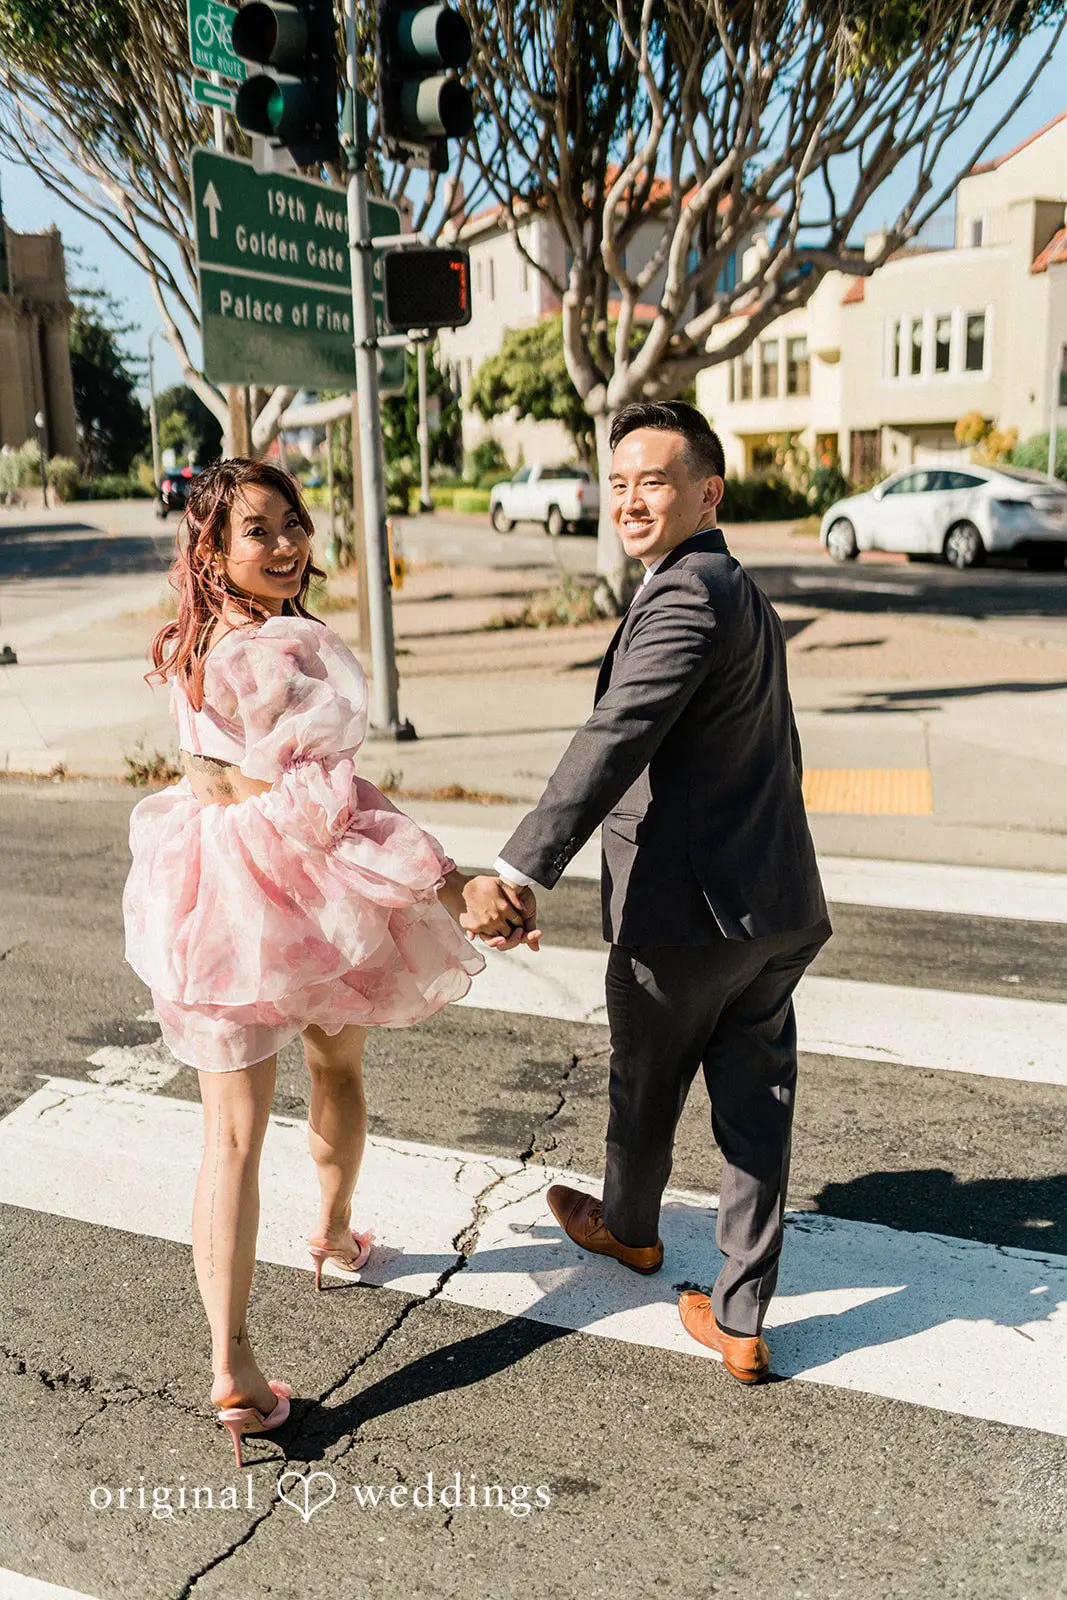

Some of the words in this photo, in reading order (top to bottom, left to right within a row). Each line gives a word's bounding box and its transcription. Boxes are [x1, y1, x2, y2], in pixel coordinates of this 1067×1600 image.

[196, 48, 214, 69] BIKE
[217, 56, 242, 78] ROUTE
[267, 189, 306, 224] 19th
[315, 202, 349, 233] Ave
[235, 224, 298, 264] Golden
[306, 240, 343, 272] Gate
[219, 290, 283, 323] Palace
[291, 301, 308, 327] of
[316, 303, 350, 333] Fine
